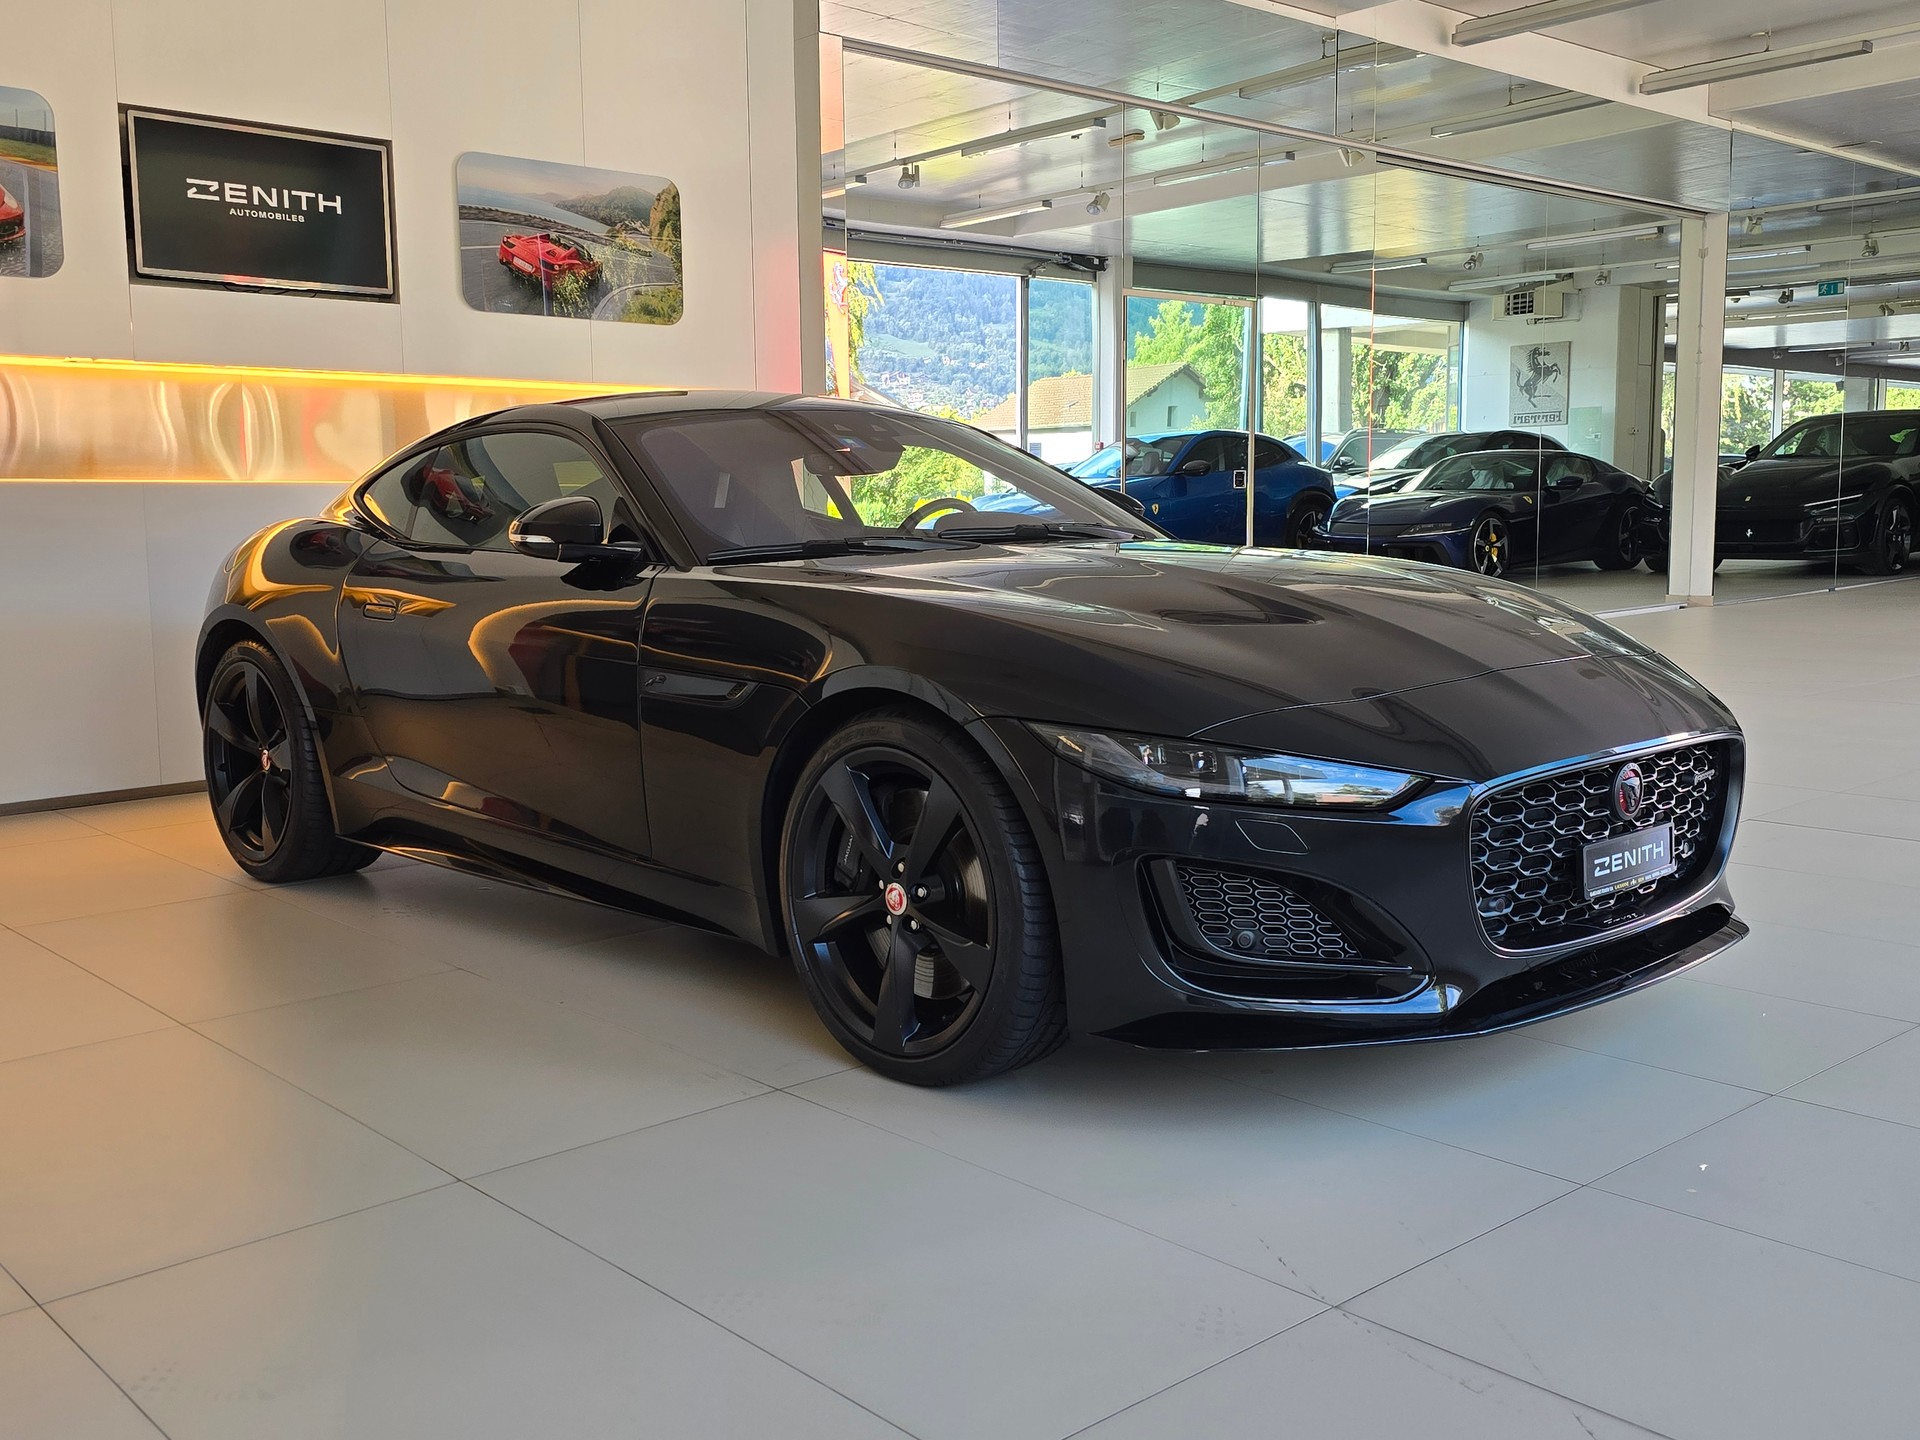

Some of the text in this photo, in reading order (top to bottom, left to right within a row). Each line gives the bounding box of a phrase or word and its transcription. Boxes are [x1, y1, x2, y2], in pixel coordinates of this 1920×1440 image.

[186, 177, 343, 215] ZENITH
[229, 207, 305, 223] AUTOMOBILES
[1594, 840, 1664, 878] ZENITH
